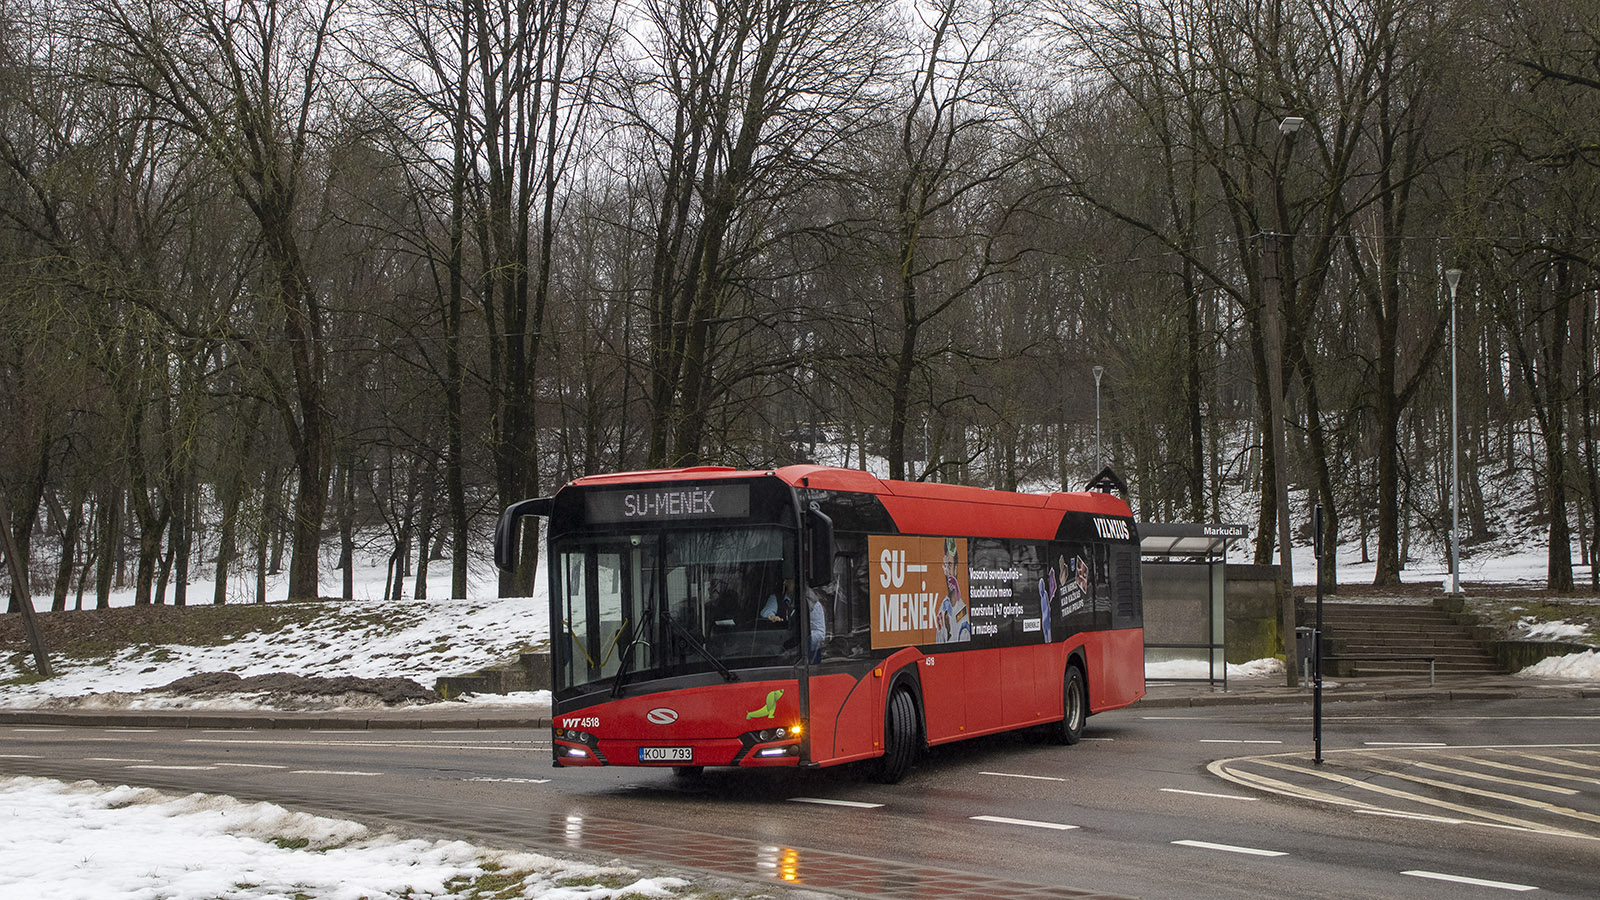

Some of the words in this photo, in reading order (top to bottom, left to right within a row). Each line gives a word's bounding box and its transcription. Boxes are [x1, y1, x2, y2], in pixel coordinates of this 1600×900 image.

[624, 487, 715, 517] SU-MENĖK
[1092, 517, 1130, 540] VILNIUS
[1203, 526, 1243, 536] Markučiai
[969, 567, 988, 579] Vasario
[998, 588, 1012, 598] meno
[879, 580, 939, 632] MENĖK
[996, 603, 1003, 616] 47
[1003, 602, 1024, 618] galerijas
[581, 717, 600, 728] 4518
[645, 749, 666, 759] KOU
[672, 748, 691, 759] 793
